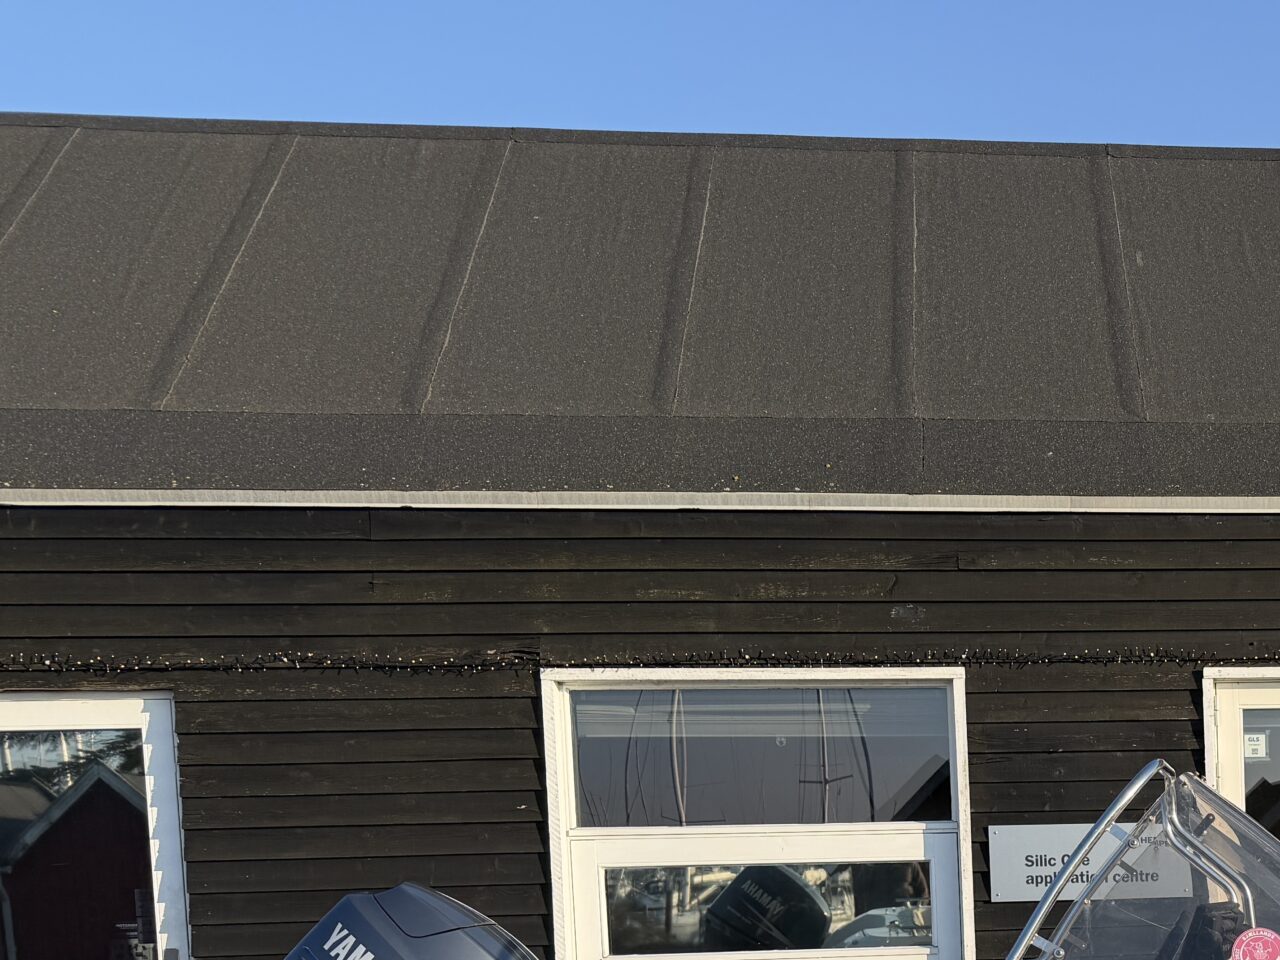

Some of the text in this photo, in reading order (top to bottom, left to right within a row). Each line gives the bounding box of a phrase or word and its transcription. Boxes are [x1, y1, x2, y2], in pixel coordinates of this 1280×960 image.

[1024, 854, 1090, 867] Silic Oe
[1113, 870, 1159, 883] centre
